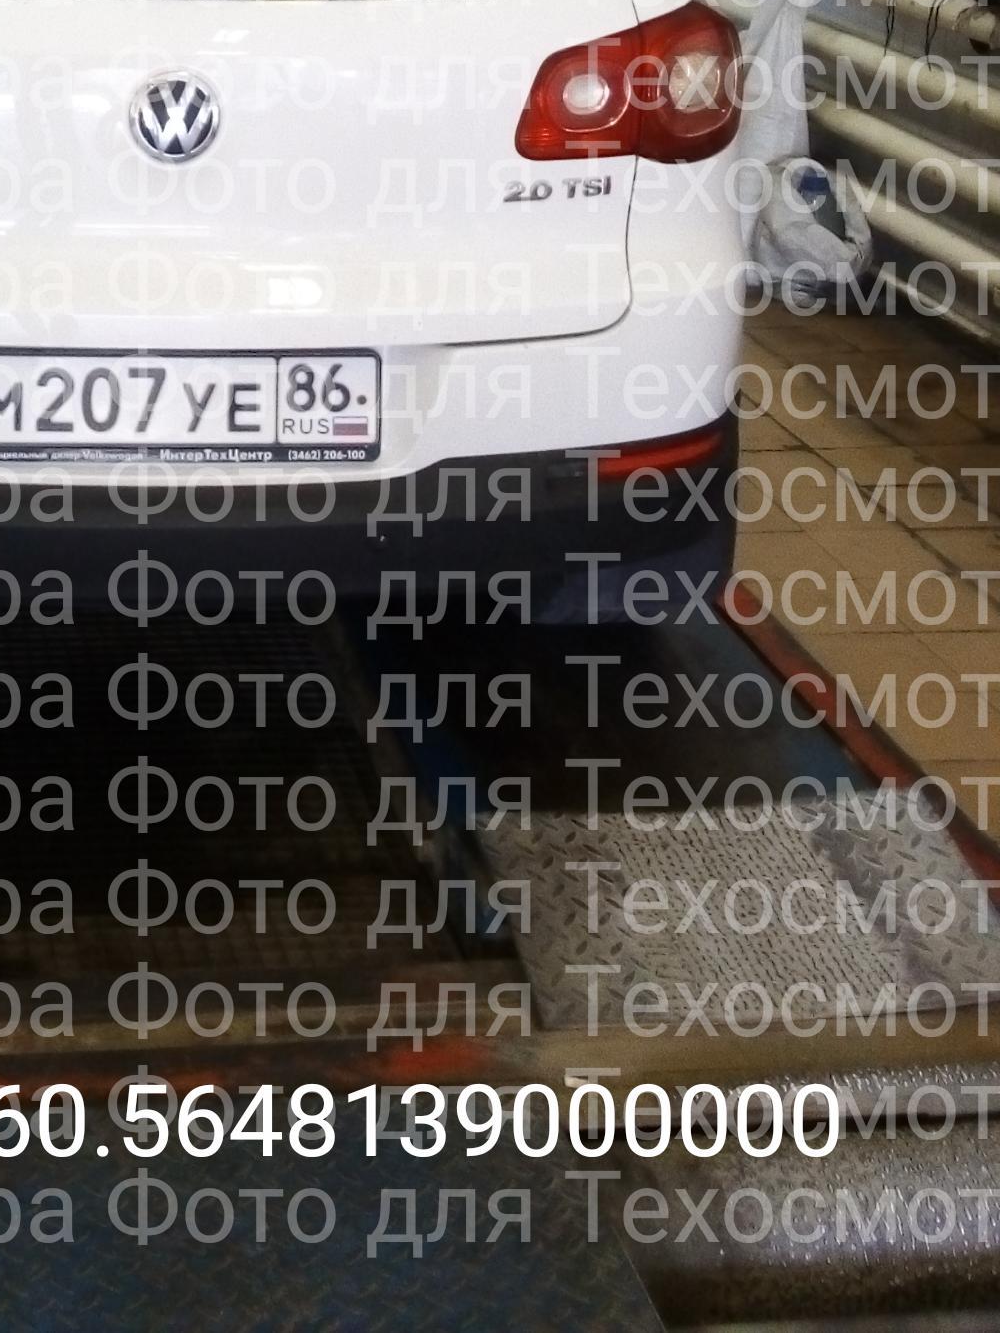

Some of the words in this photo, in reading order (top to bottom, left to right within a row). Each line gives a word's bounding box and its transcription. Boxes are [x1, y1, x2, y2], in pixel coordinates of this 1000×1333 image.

[562, 175, 611, 199] TSI
[286, 363, 351, 413] 86
[282, 418, 330, 435] RUS
[159, 449, 273, 462] ИнтерТехЦентр
[288, 449, 320, 461] (3462)
[323, 449, 366, 460] 206-100
